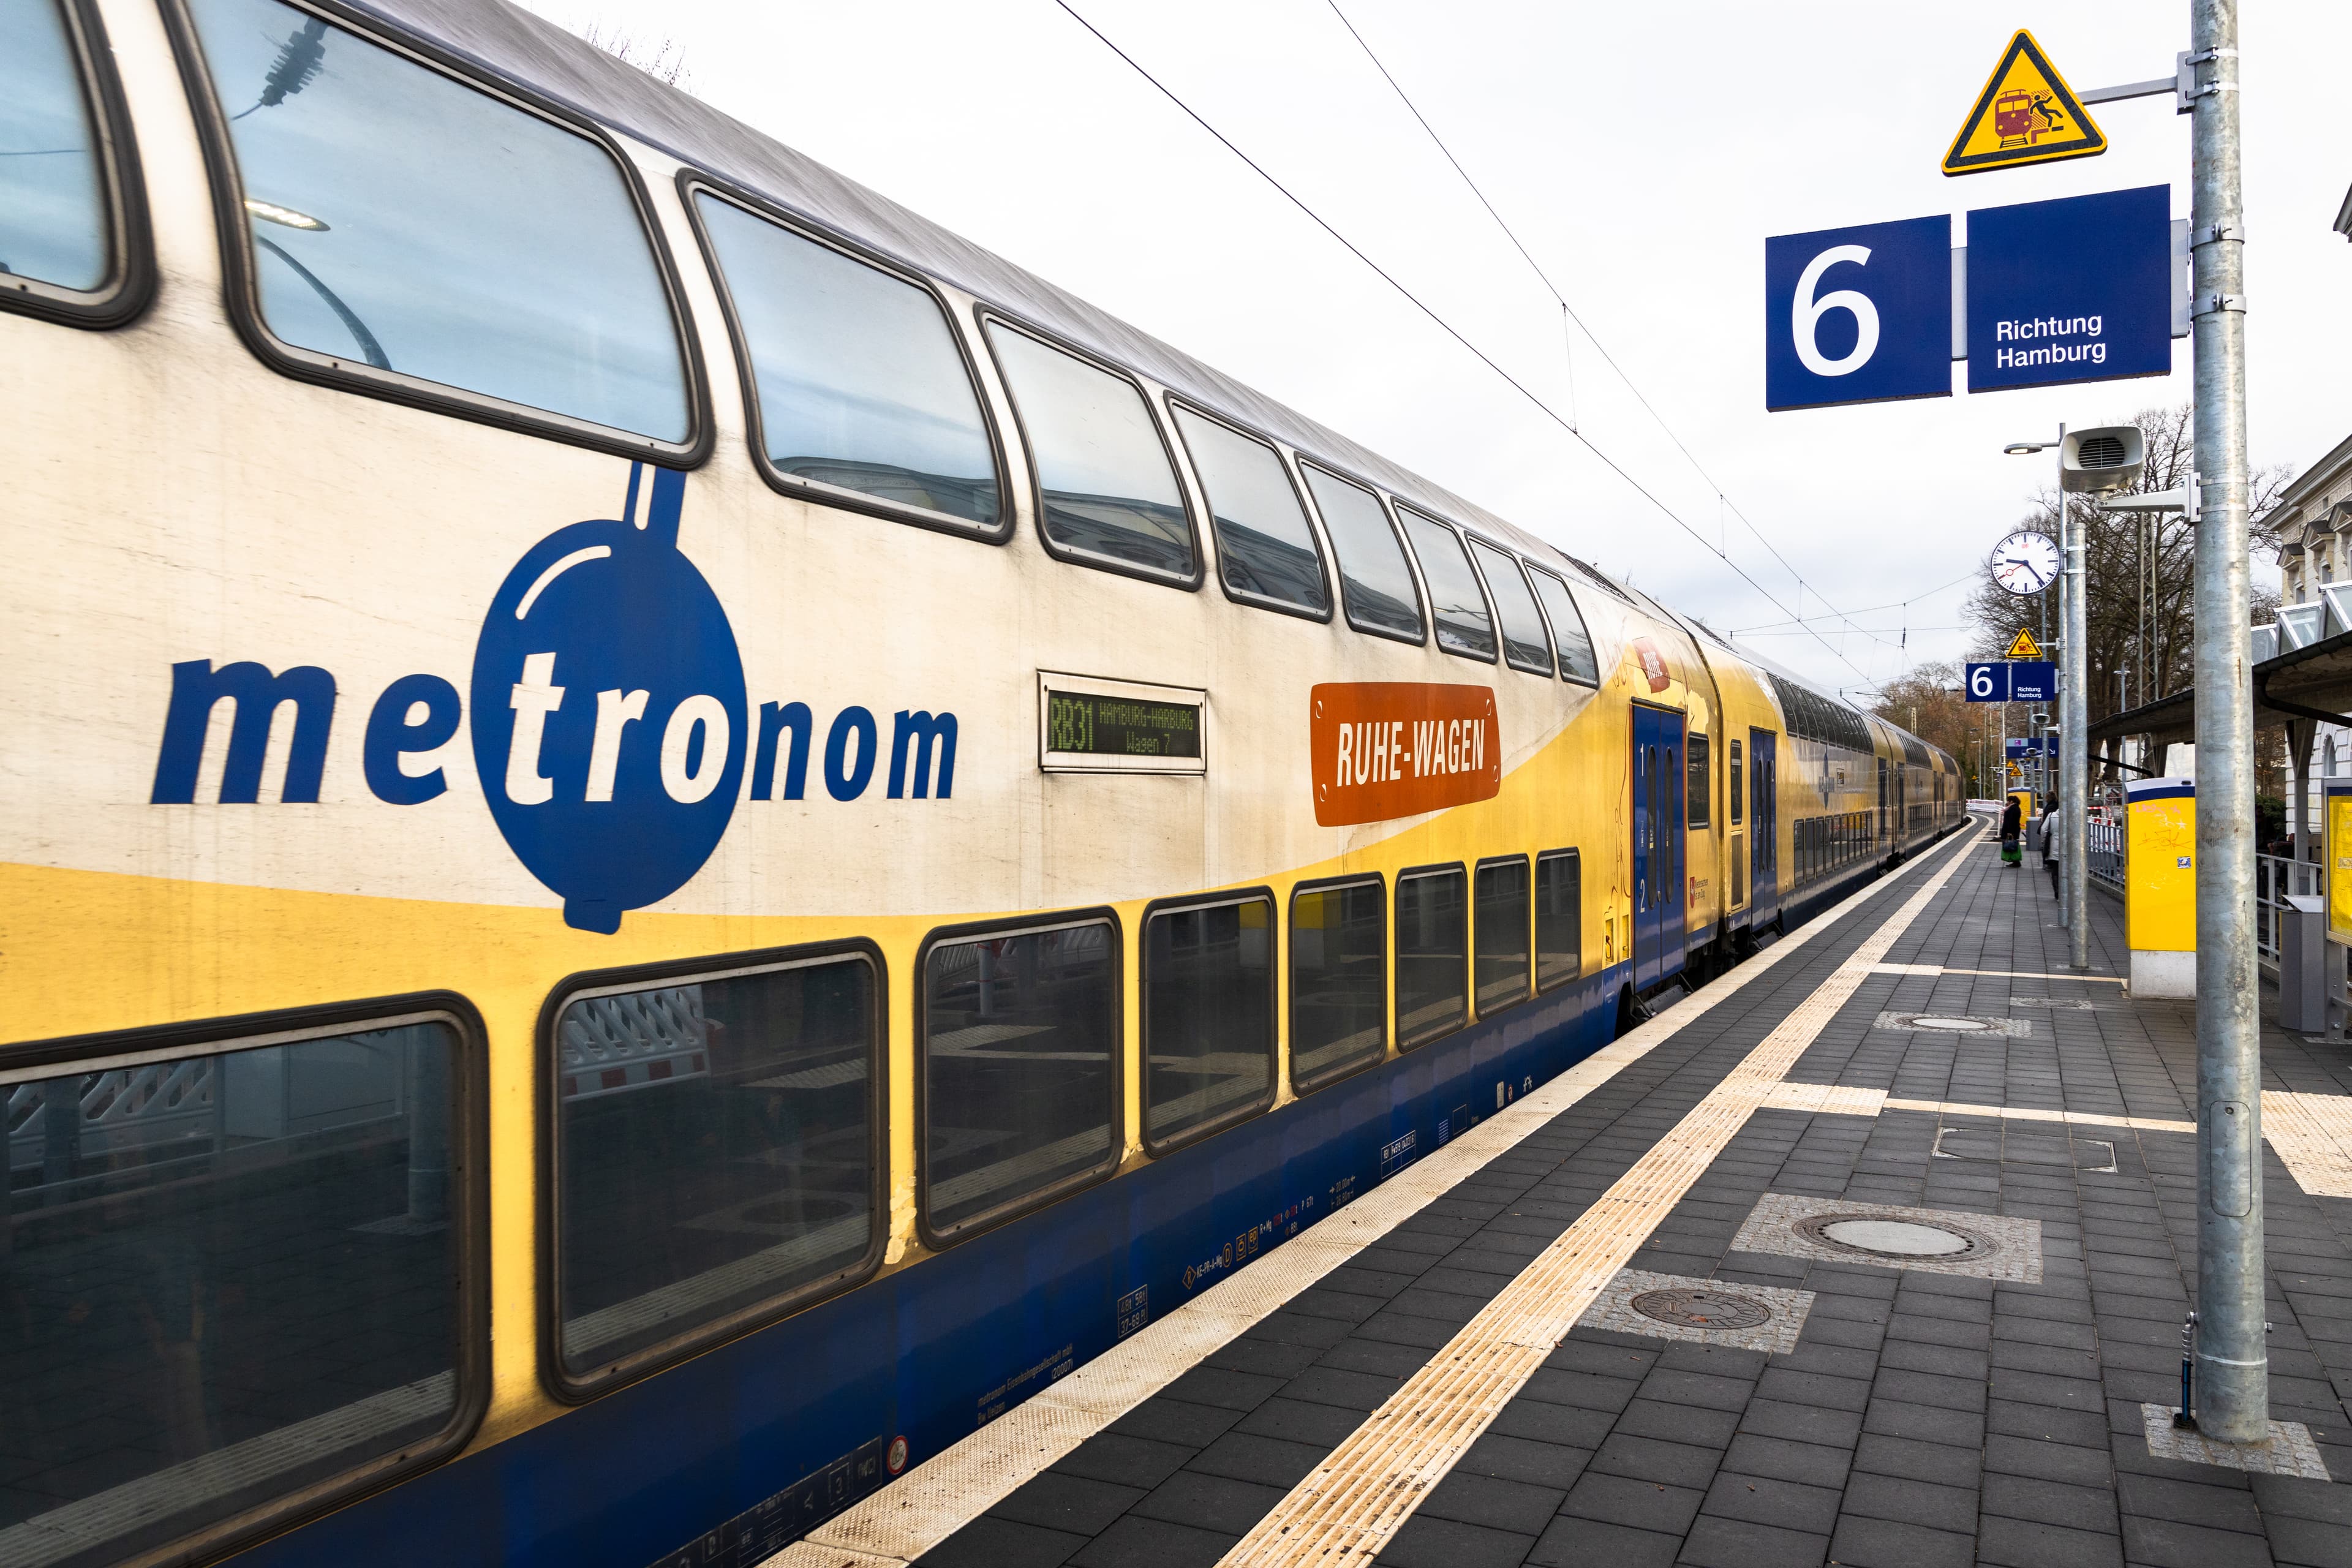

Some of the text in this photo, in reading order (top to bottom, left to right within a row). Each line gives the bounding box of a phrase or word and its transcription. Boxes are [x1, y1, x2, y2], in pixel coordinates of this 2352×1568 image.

[1792, 244, 1880, 377] 6
[1997, 315, 2102, 342] Richtung
[1997, 342, 2106, 369] Hamburg
[1972, 666, 1993, 697] 6
[150, 652, 958, 806] metronom
[1050, 697, 1193, 751] RB31 HAMBURG-HARBURG
[1126, 731, 1170, 754] Wagen 7
[1336, 719, 1485, 788] RUHE-WAGEN
[1640, 878, 1645, 913] 2
